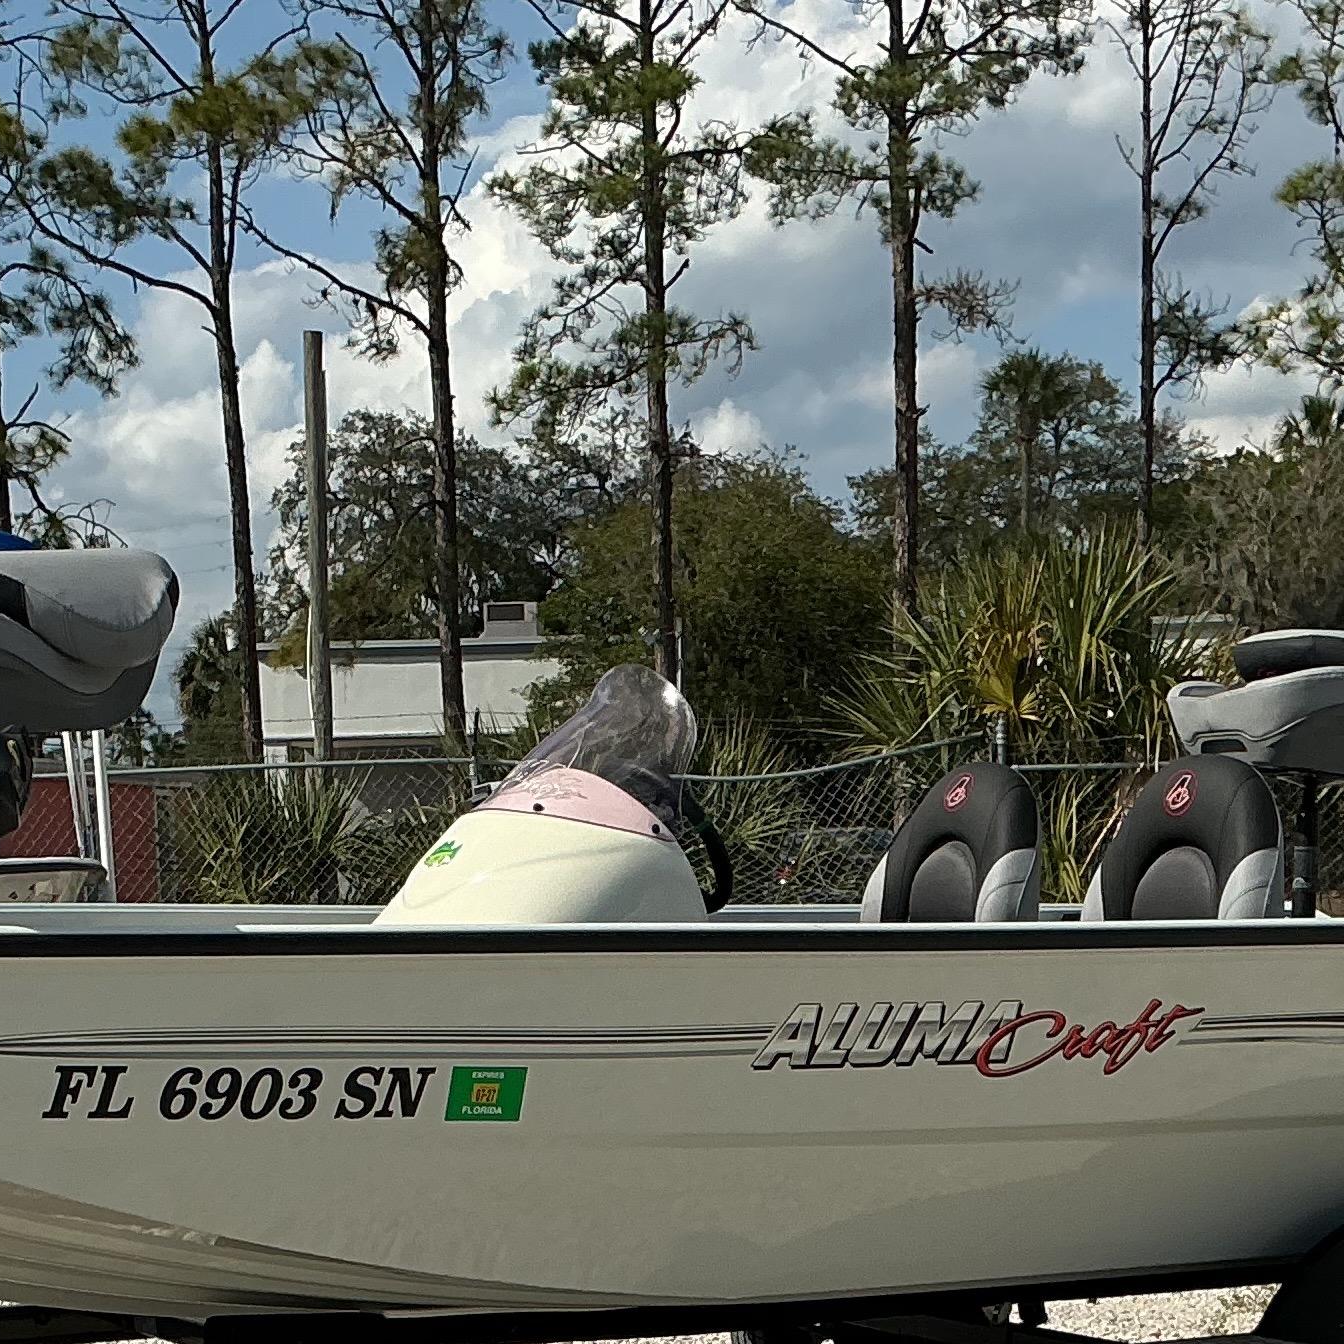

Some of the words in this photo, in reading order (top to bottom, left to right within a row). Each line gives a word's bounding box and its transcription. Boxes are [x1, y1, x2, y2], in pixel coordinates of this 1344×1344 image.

[42, 1065, 135, 1119] FL
[158, 1066, 323, 1120] 6903
[333, 1066, 438, 1120] SN
[461, 1105, 503, 1115] FLORIDA
